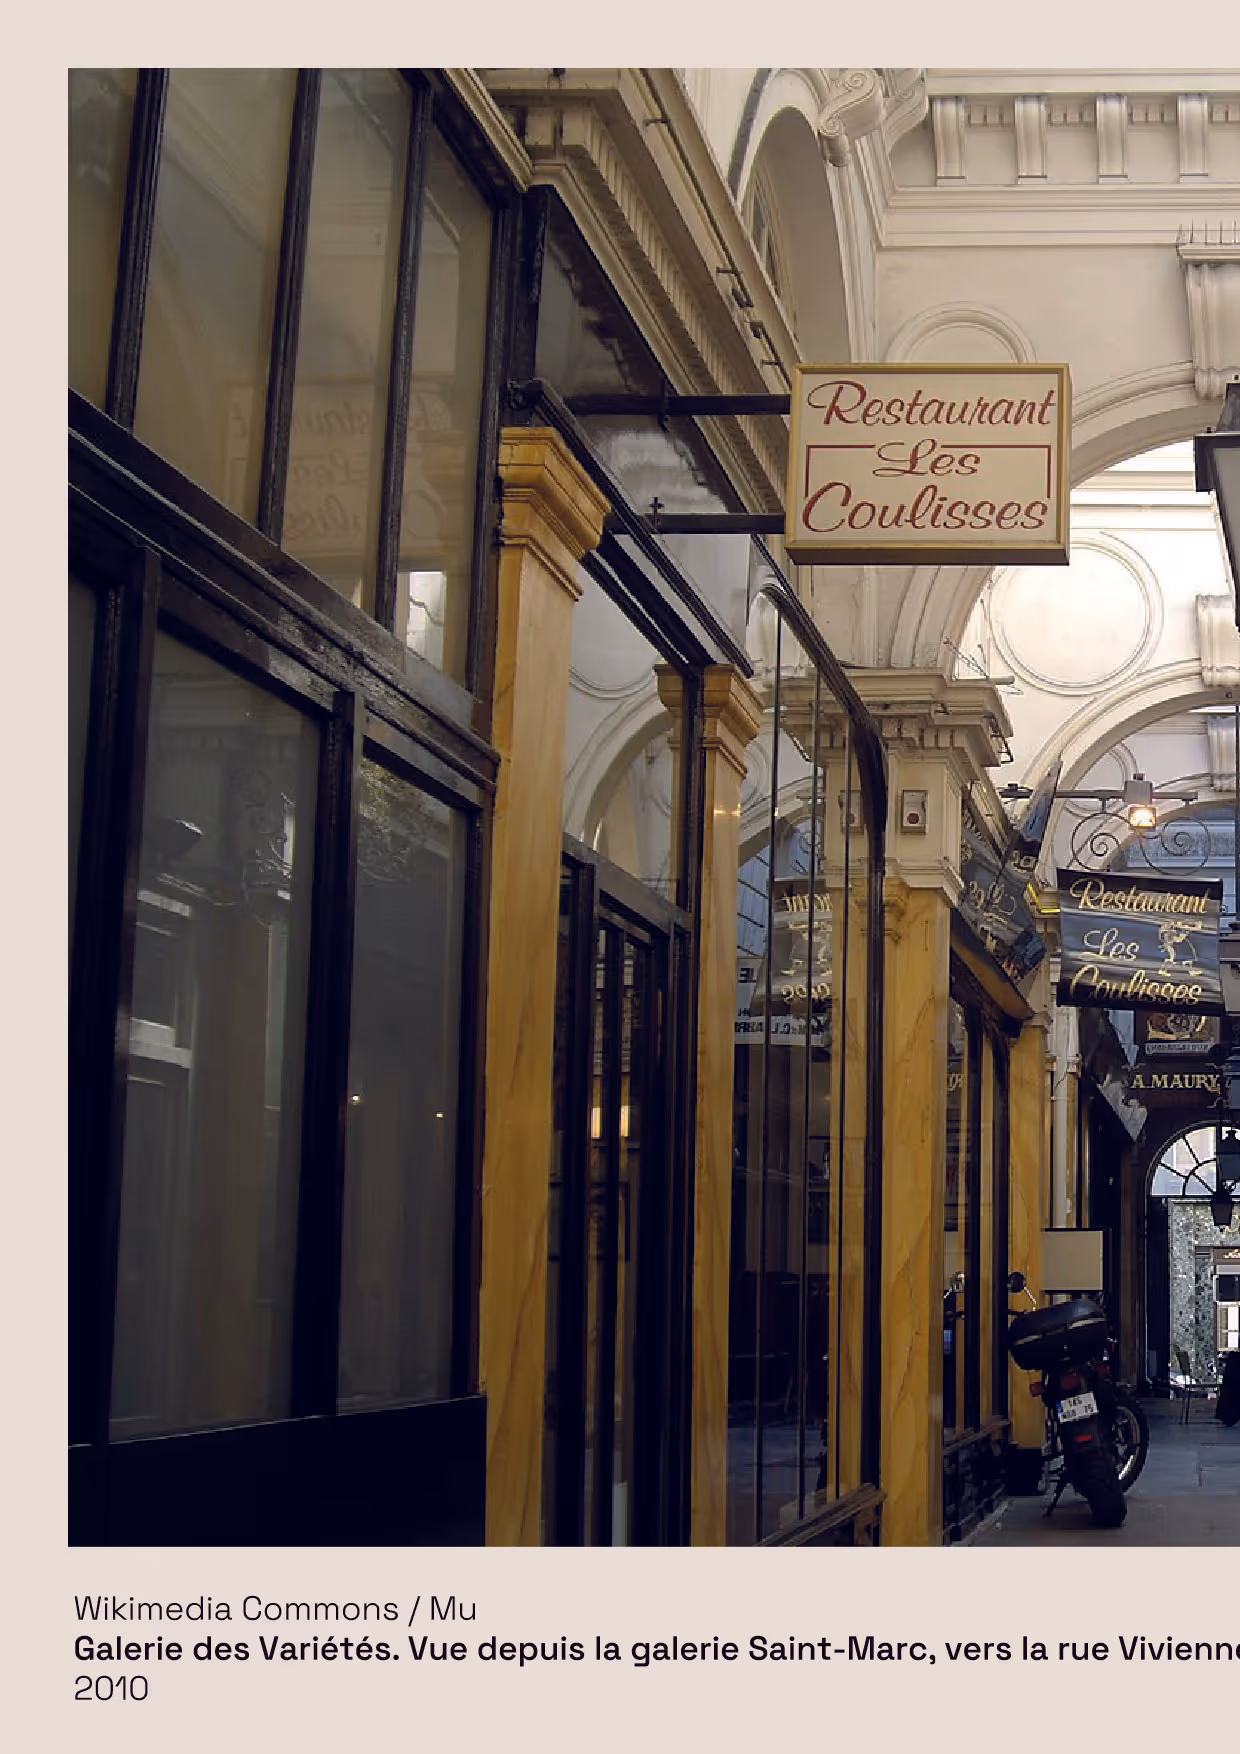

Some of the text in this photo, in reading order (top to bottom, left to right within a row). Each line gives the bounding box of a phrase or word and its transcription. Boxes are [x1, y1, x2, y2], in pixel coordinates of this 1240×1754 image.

[807, 380, 1057, 426] Restaurant
[872, 438, 981, 478] Les
[802, 481, 1048, 533] Coulisses
[1069, 877, 1212, 914] Restaurant
[1083, 927, 1140, 961] Les
[1069, 964, 1203, 1006] Coulisses
